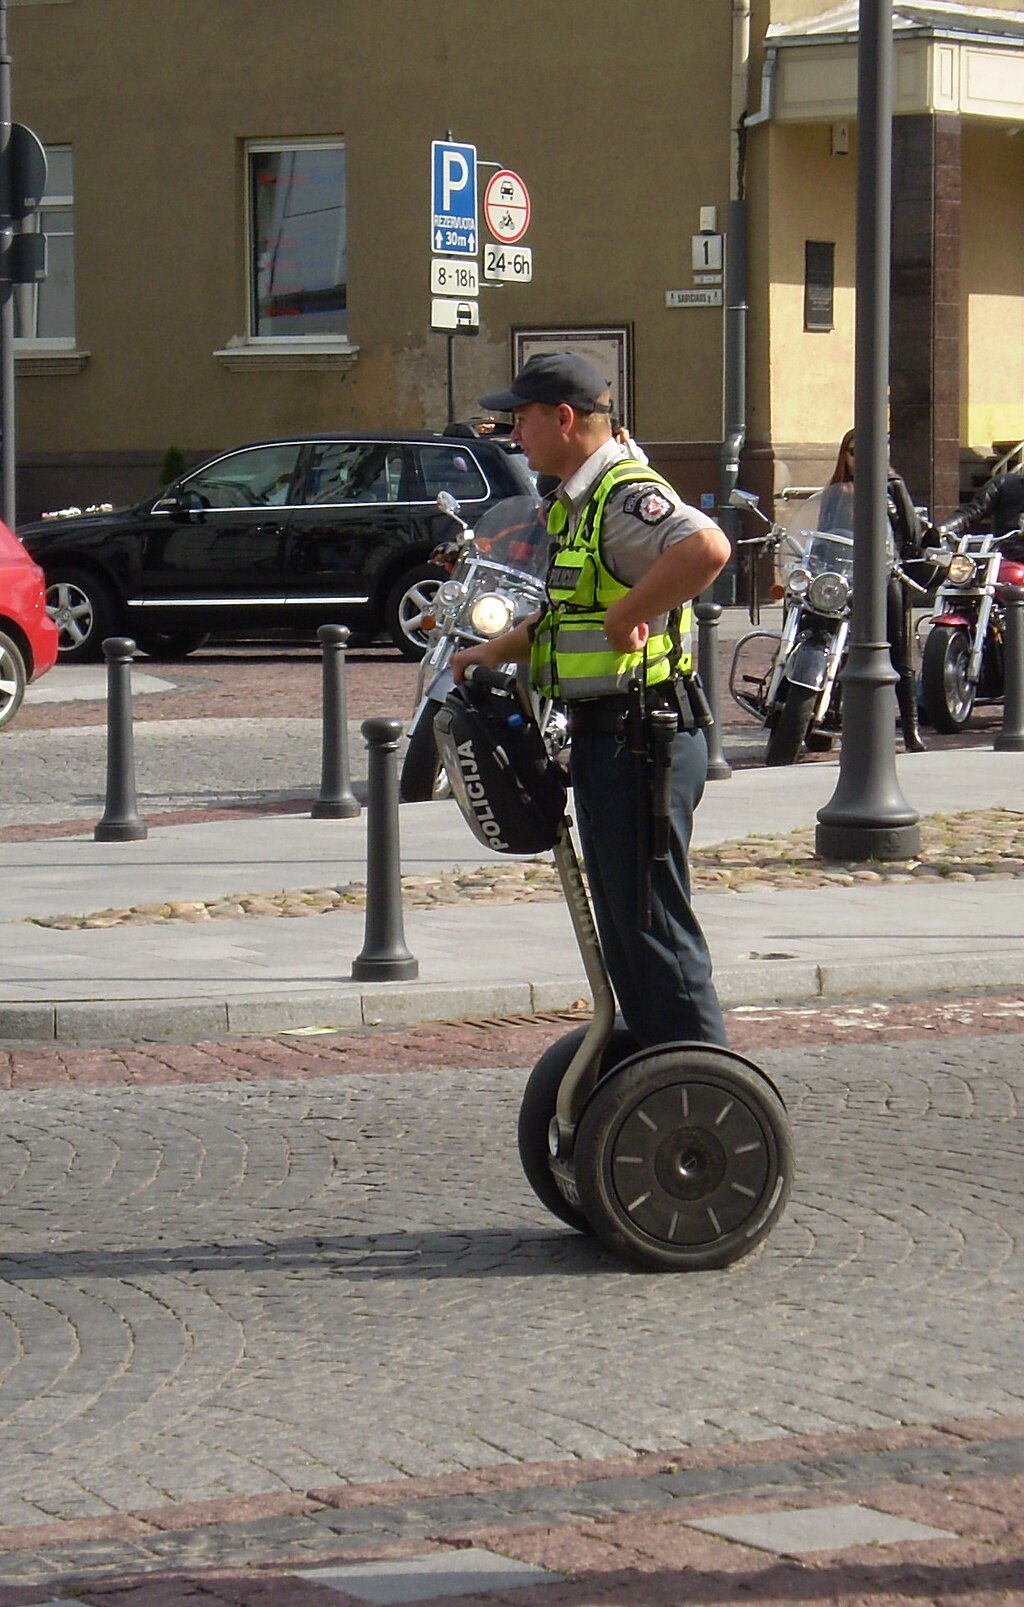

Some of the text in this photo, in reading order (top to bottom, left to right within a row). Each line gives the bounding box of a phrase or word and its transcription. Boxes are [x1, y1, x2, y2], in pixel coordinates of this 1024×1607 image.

[442, 150, 469, 211] P
[445, 231, 467, 247] 30m
[487, 251, 530, 275] 24-6h
[702, 240, 709, 265] 1
[457, 739, 510, 851] POLICIJA
